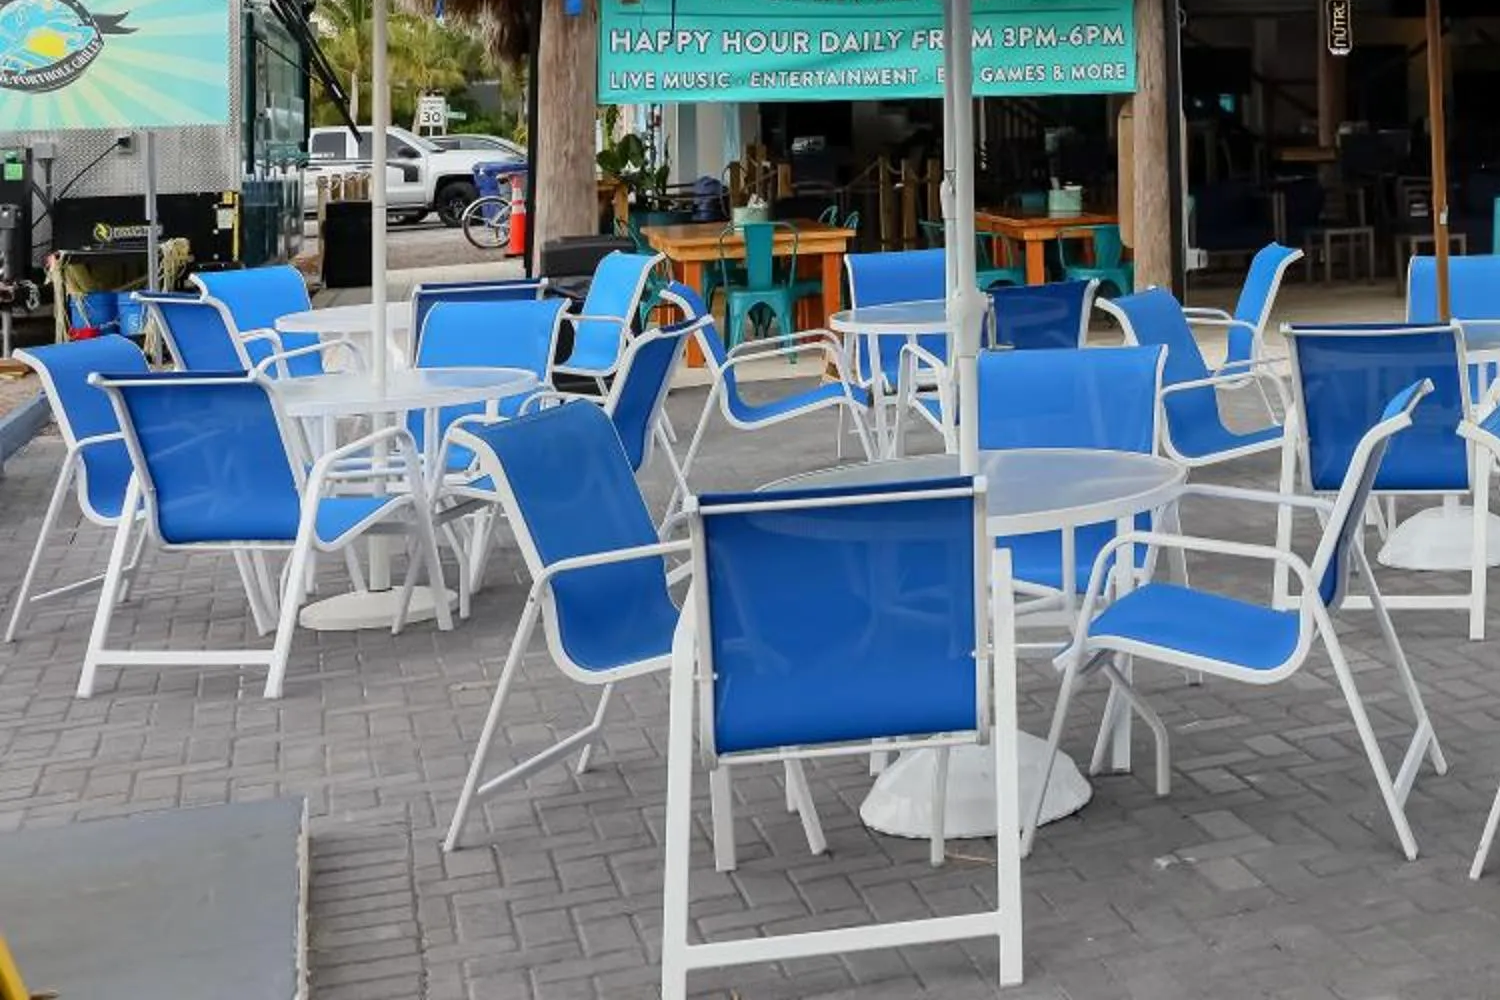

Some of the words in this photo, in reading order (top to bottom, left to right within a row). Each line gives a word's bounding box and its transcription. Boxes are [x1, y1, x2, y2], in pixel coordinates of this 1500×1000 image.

[609, 28, 711, 53] HAPPY
[721, 30, 811, 54] HOUR
[819, 29, 903, 53] DAILY
[911, 28, 993, 50] FRM
[1002, 25, 1125, 48] 3PM-6PM
[610, 71, 656, 90] LIVE
[663, 71, 731, 89] MUSIC
[750, 67, 919, 89] ENTERTAINMENT
[980, 64, 1046, 83] GAMES
[1052, 64, 1064, 81] &
[1071, 63, 1126, 80] MORE
[422, 111, 441, 122] 30
